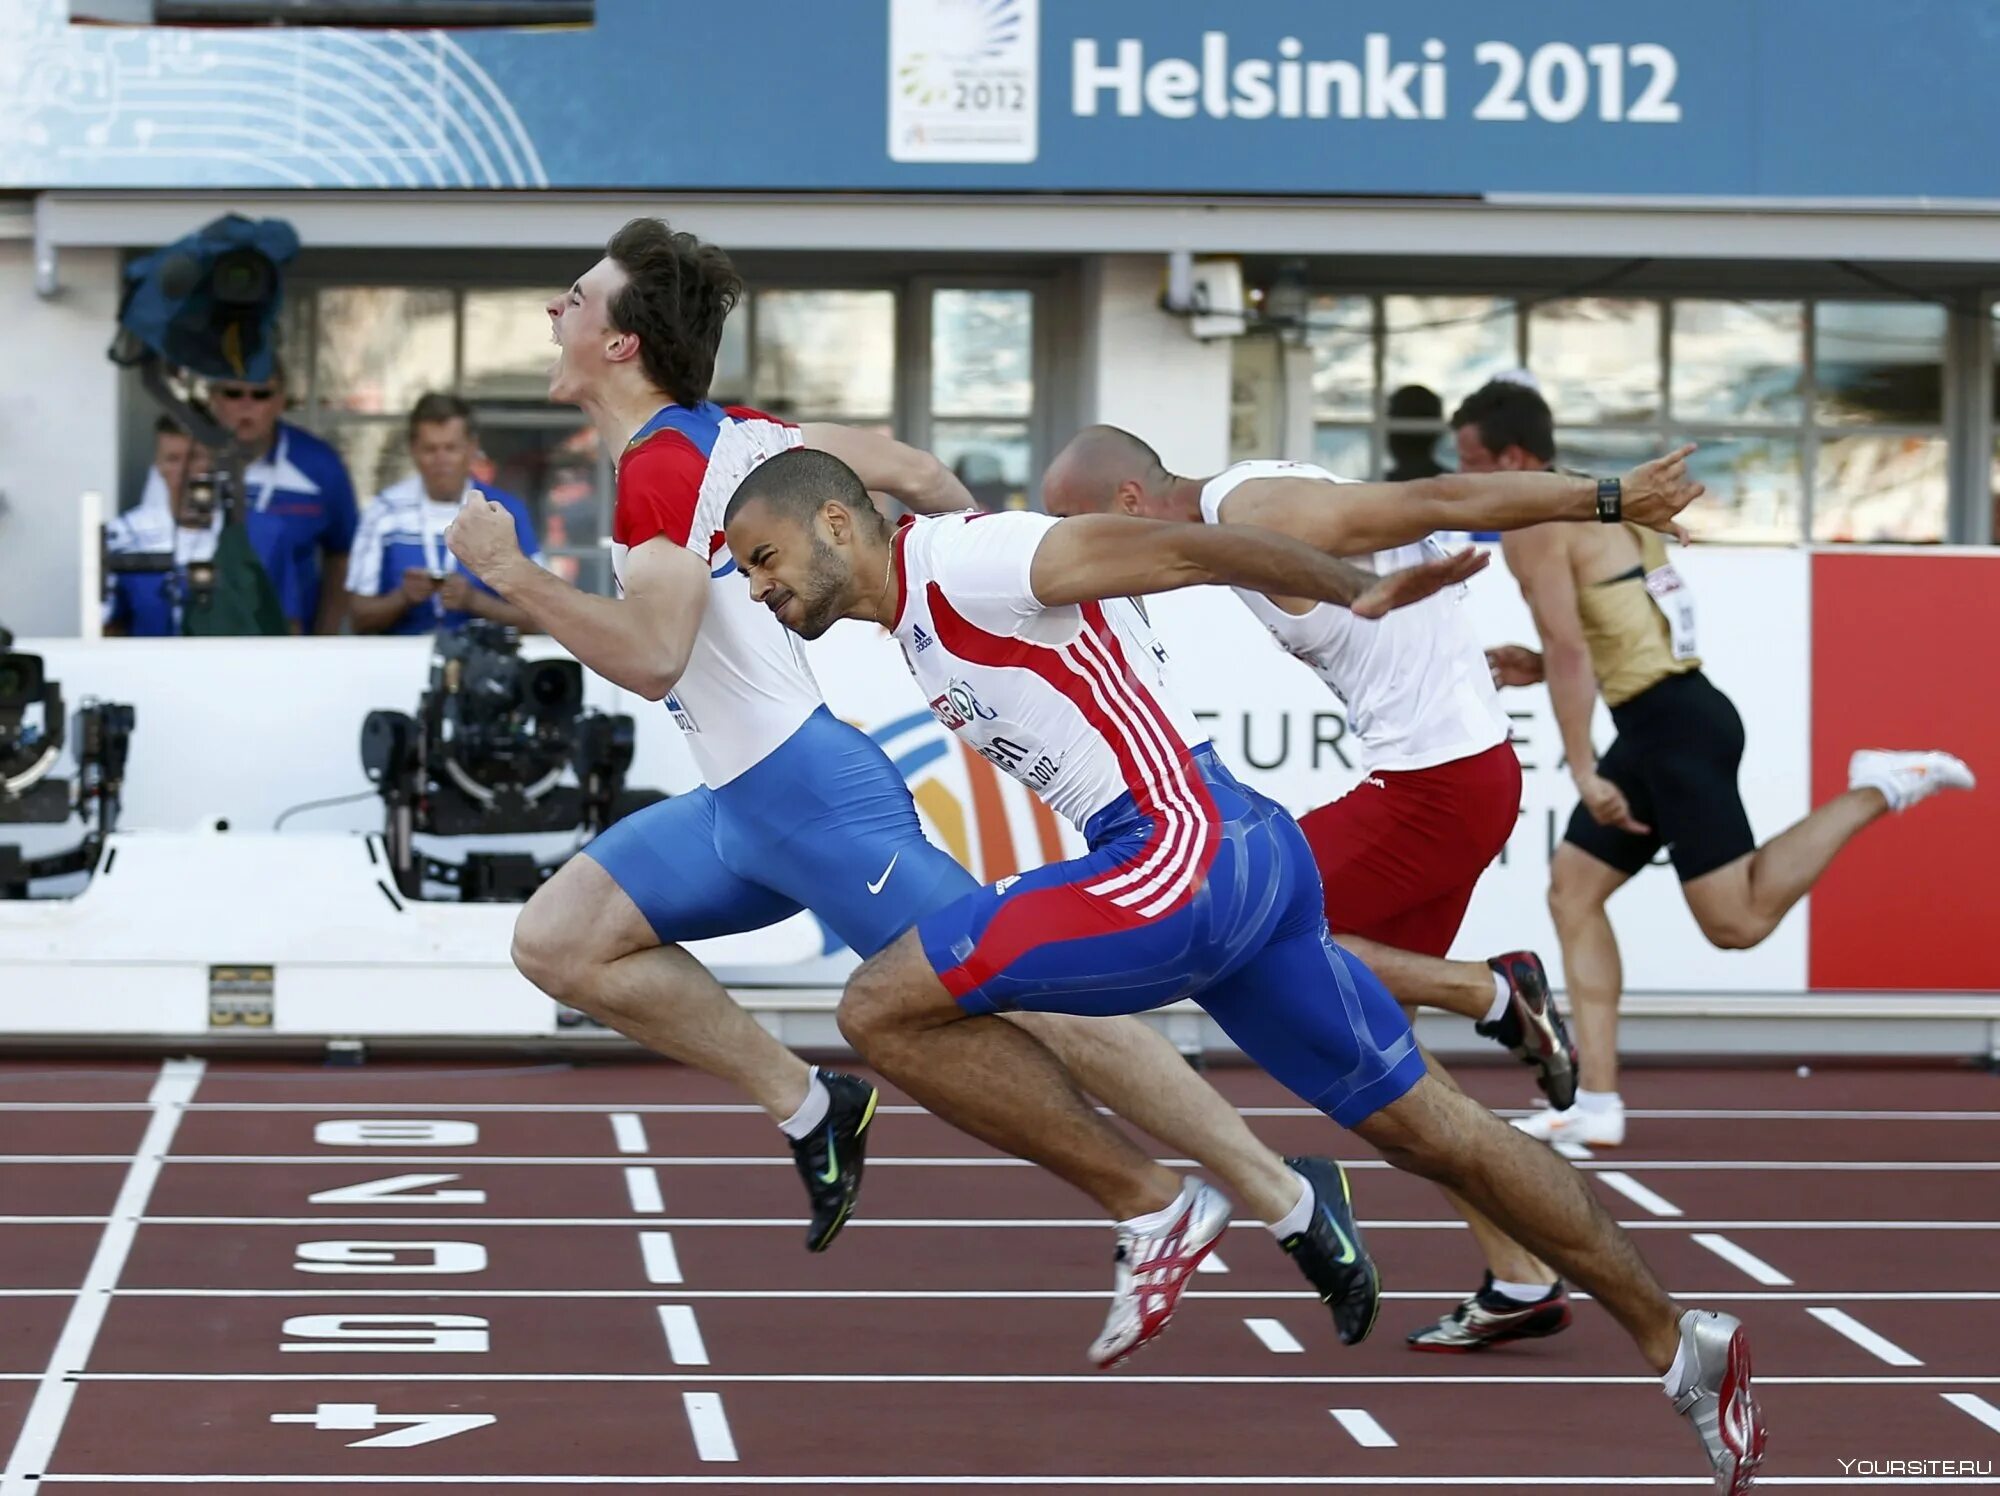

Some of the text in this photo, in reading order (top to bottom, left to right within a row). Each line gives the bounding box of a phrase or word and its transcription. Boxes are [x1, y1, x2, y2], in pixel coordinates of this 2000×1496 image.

[1073, 31, 1681, 122] Helsinki 2012
[952, 82, 1025, 112] 2012
[1028, 755, 1059, 787] 2012
[308, 1173, 486, 1203] 7
[293, 1240, 488, 1274] 6
[279, 1314, 490, 1353] 5
[270, 1403, 497, 1448] 4
